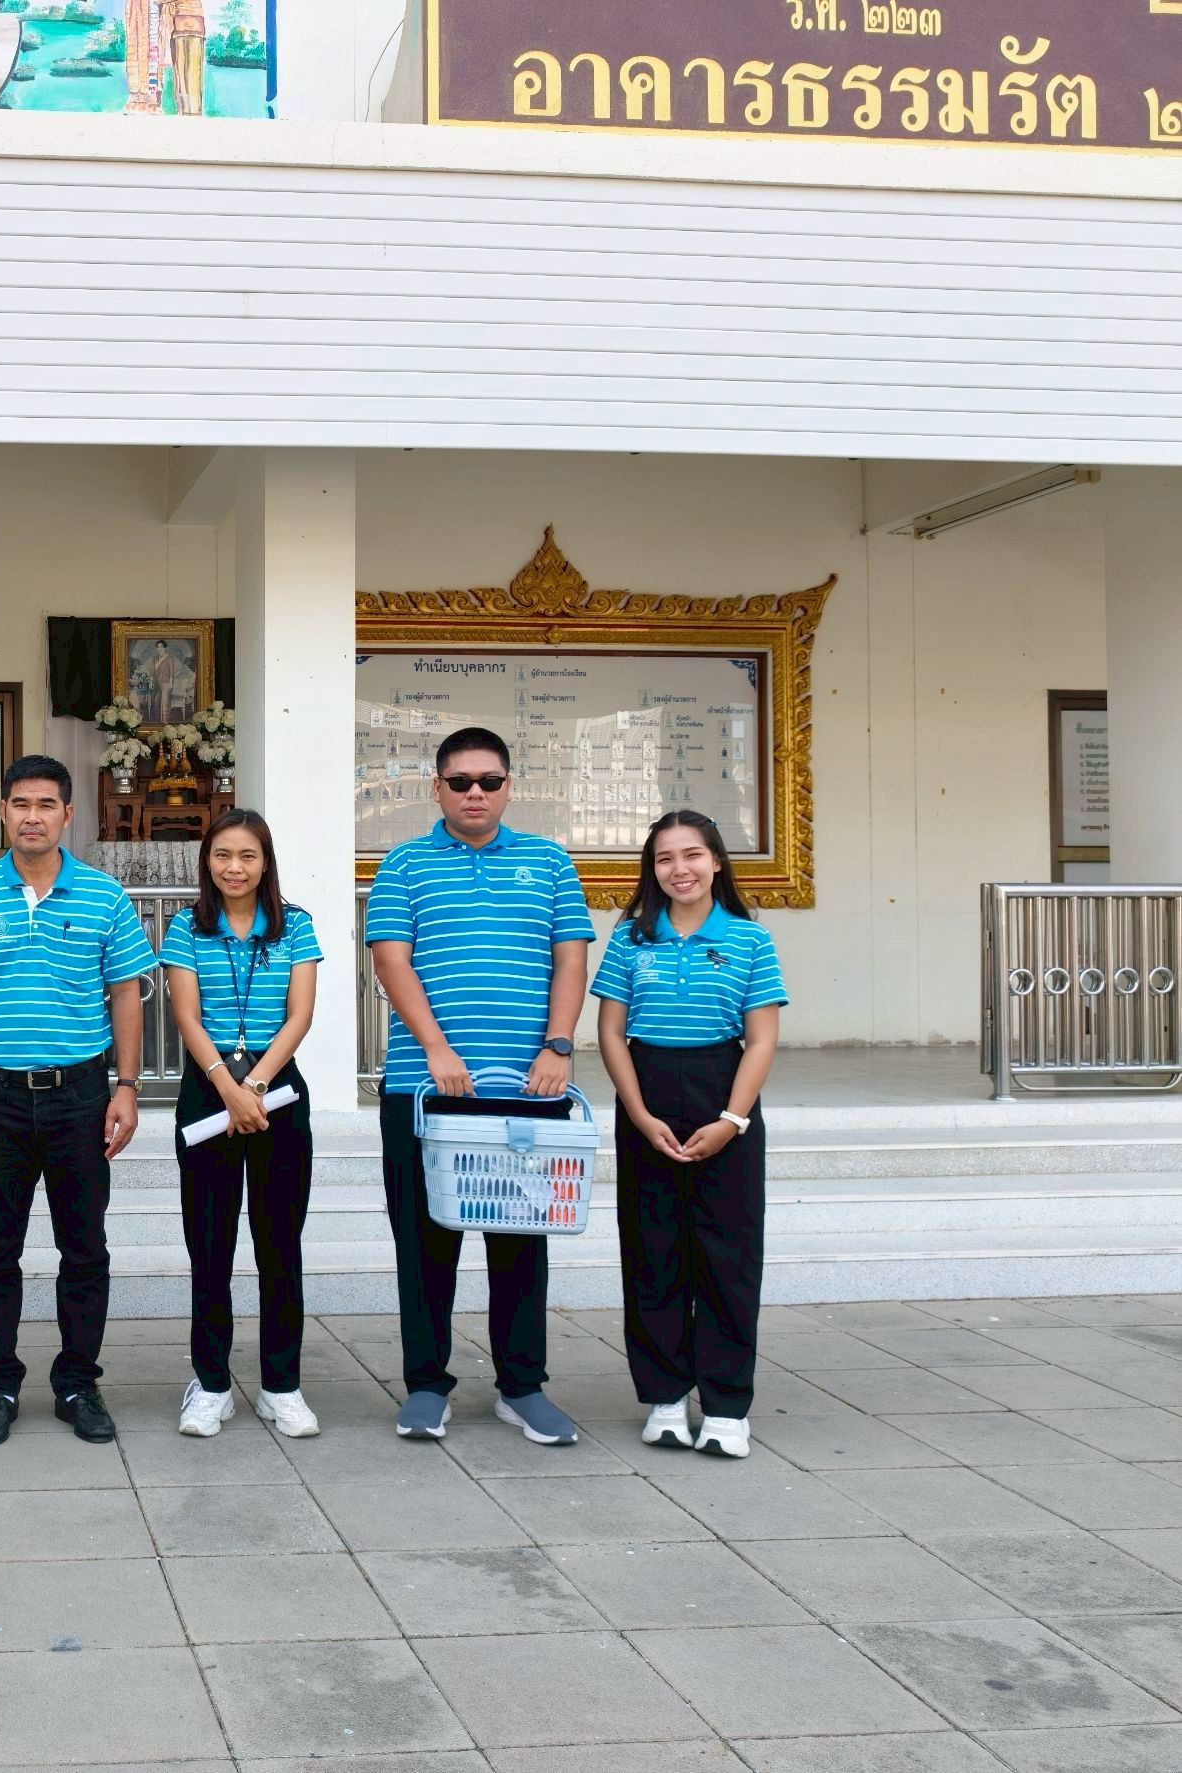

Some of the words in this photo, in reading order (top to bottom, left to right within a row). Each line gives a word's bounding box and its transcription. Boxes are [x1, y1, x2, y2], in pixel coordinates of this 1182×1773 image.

[512, 35, 1097, 139] อาคารธรรมรัต
[413, 657, 507, 678] ทำเนียบบุคลากร
